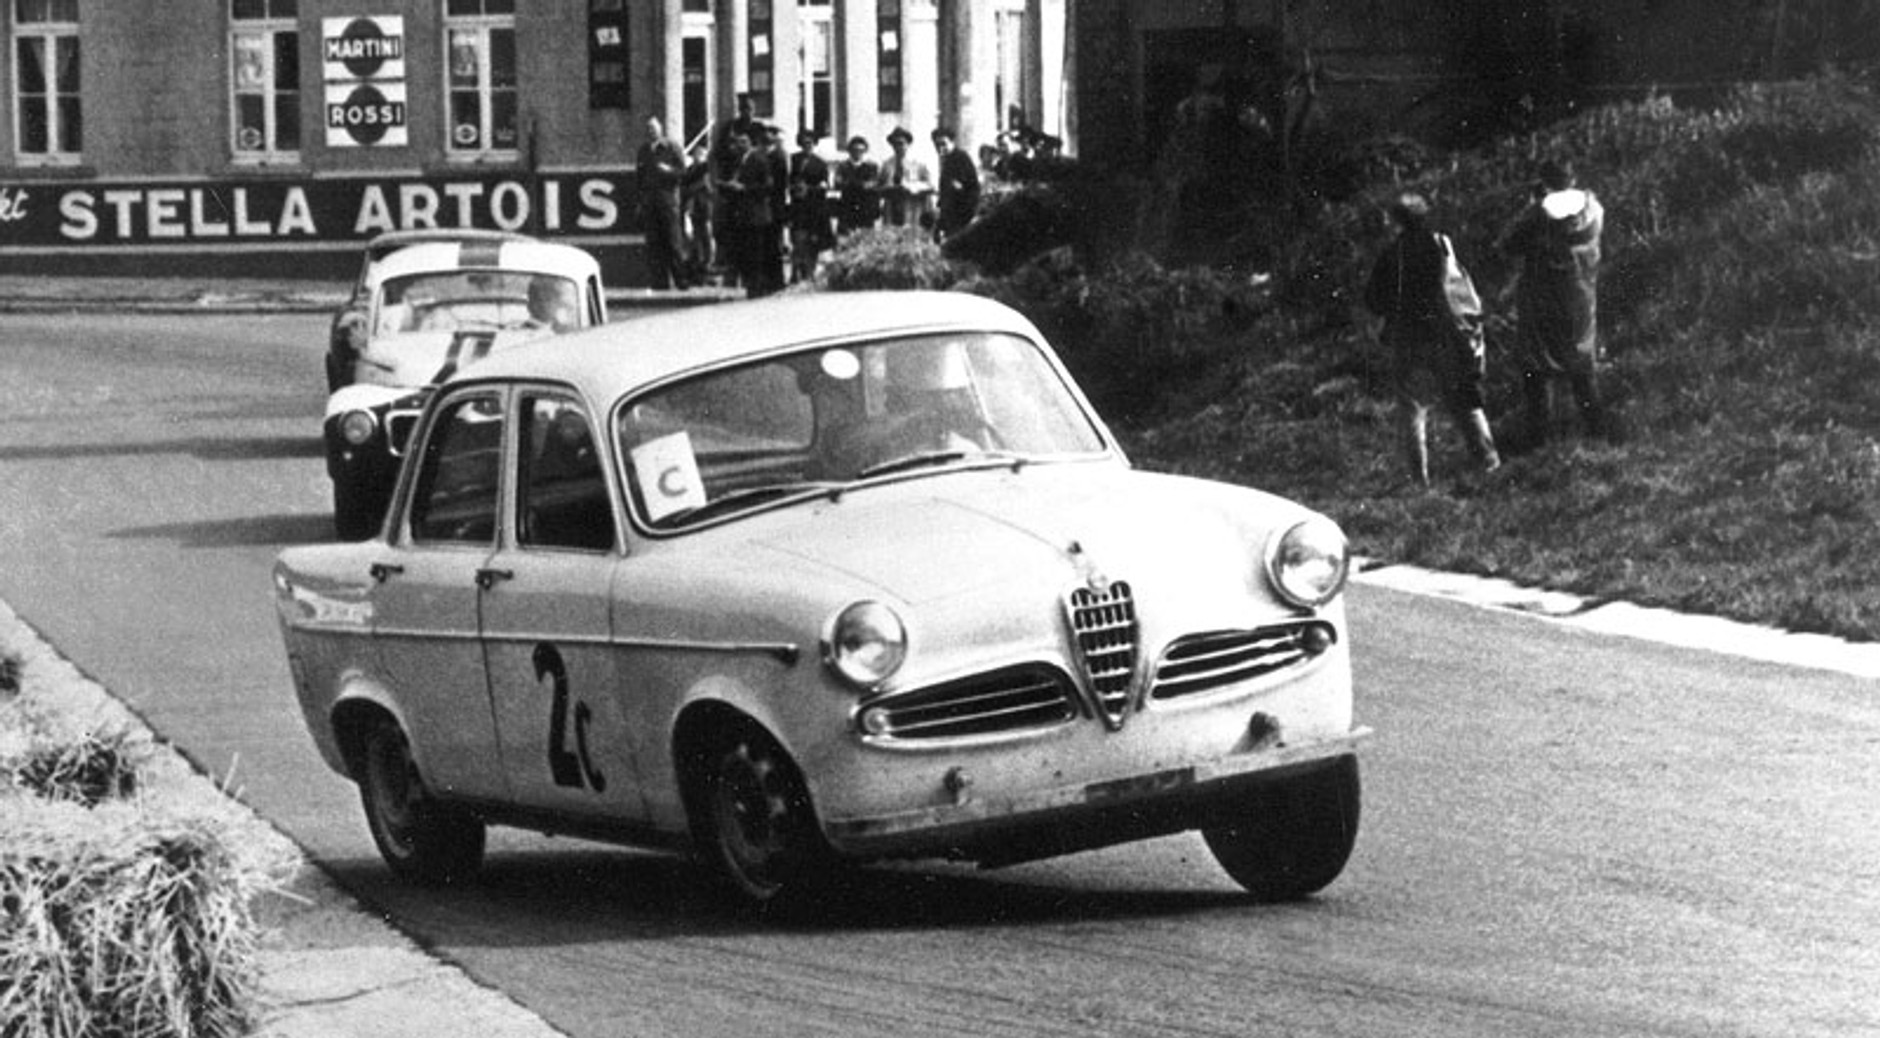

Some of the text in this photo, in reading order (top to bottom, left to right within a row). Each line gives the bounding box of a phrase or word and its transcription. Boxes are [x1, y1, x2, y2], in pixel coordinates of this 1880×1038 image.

[326, 38, 400, 58] MARTINI
[330, 104, 402, 126] ROSSI
[59, 188, 317, 239] STELLA
[355, 180, 619, 234] ARTOIS
